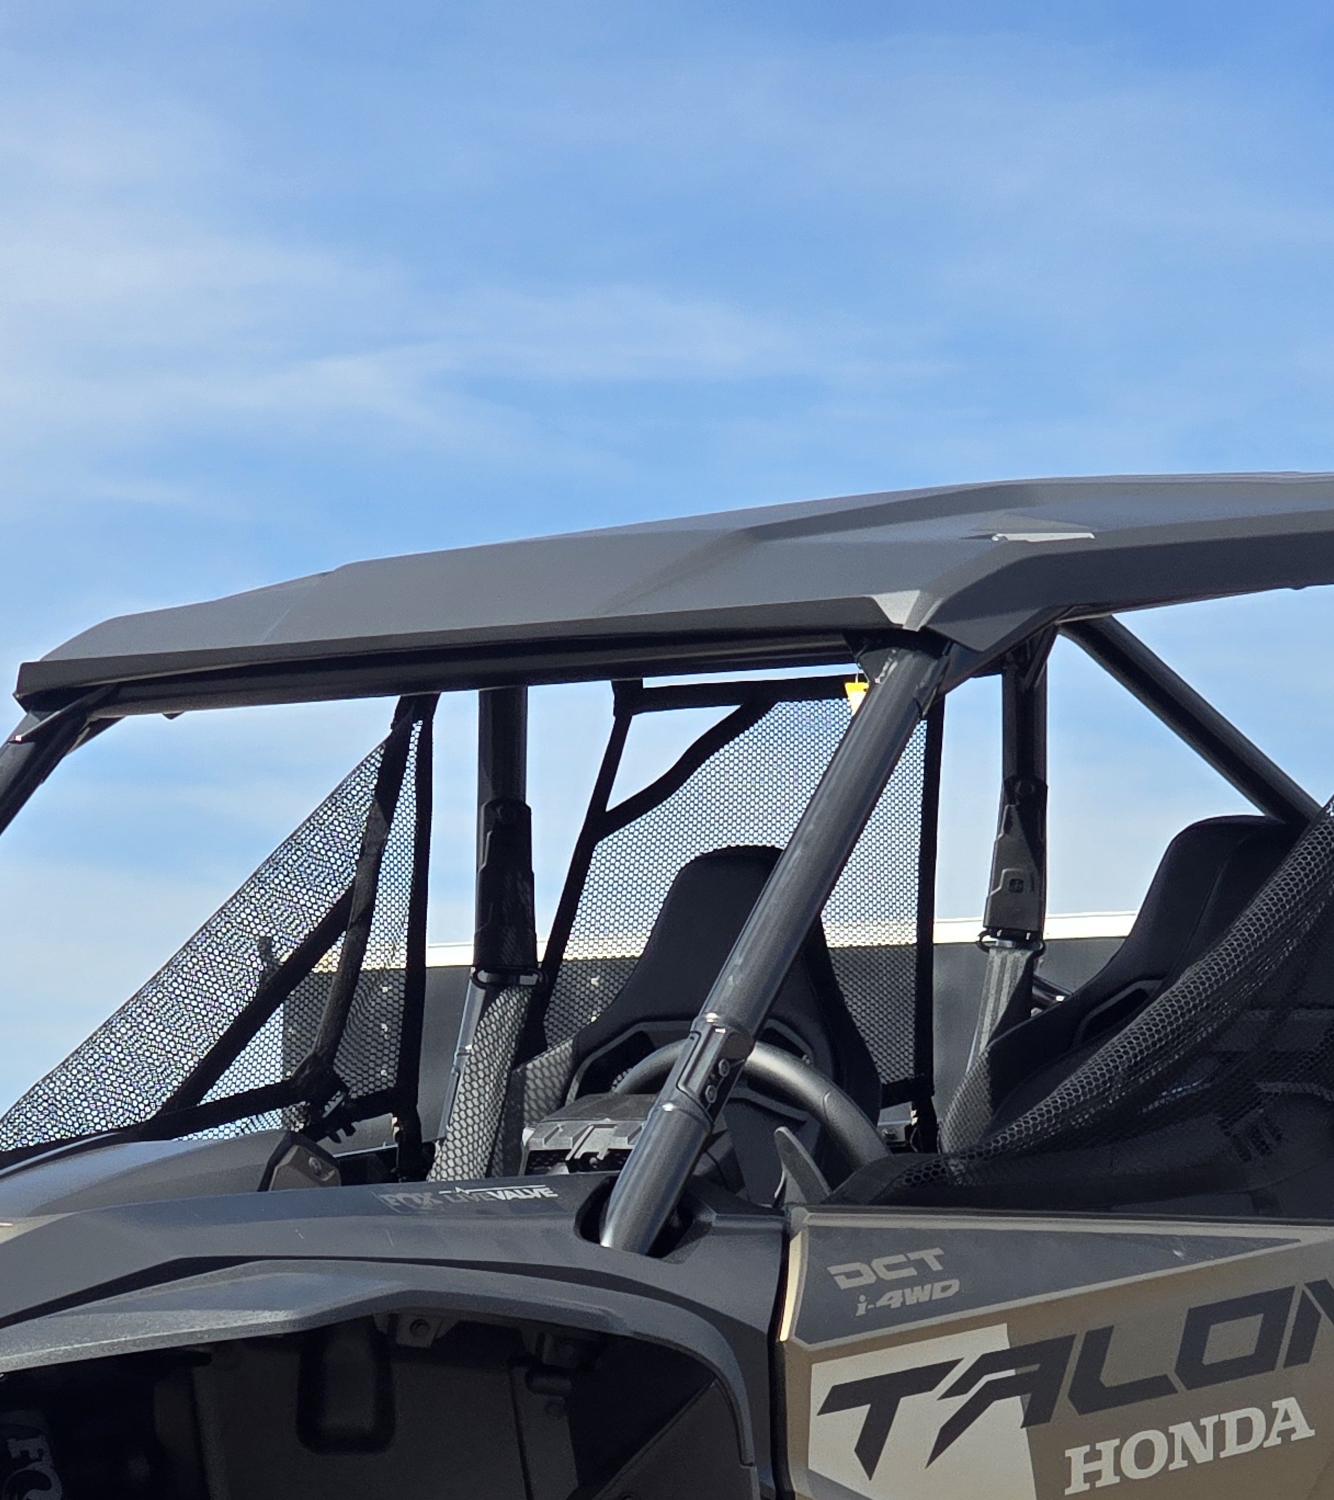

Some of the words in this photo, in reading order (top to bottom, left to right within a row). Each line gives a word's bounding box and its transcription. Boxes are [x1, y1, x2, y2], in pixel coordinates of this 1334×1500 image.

[826, 1247, 945, 1290] DCT
[855, 1278, 960, 1317] i-4WD
[1064, 1396, 1315, 1496] HONDA
